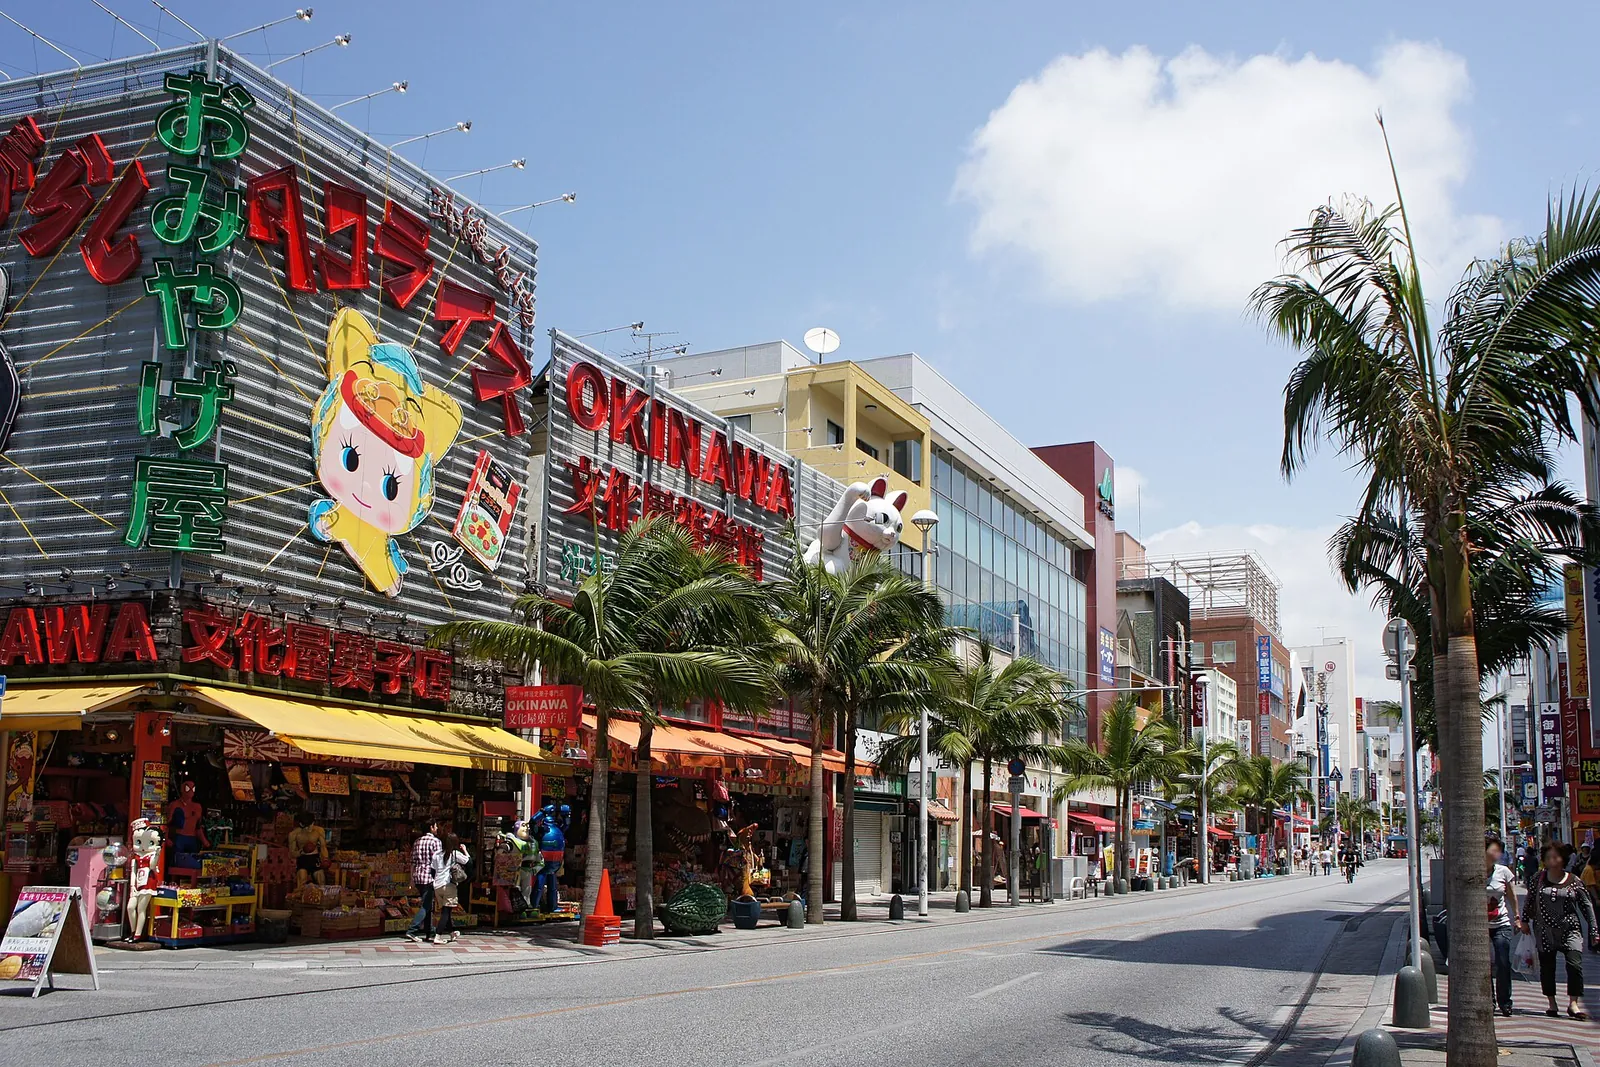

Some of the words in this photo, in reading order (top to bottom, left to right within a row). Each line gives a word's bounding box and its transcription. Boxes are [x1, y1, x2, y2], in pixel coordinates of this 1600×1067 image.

[123, 69, 256, 554] おみやげ屋
[247, 164, 532, 437] タコライス
[566, 361, 795, 520] OKINAWA
[181, 603, 452, 700] 文化屋菓子店
[507, 698, 569, 712] OKINAWA
[508, 712, 567, 726] 文化屋菓子店
